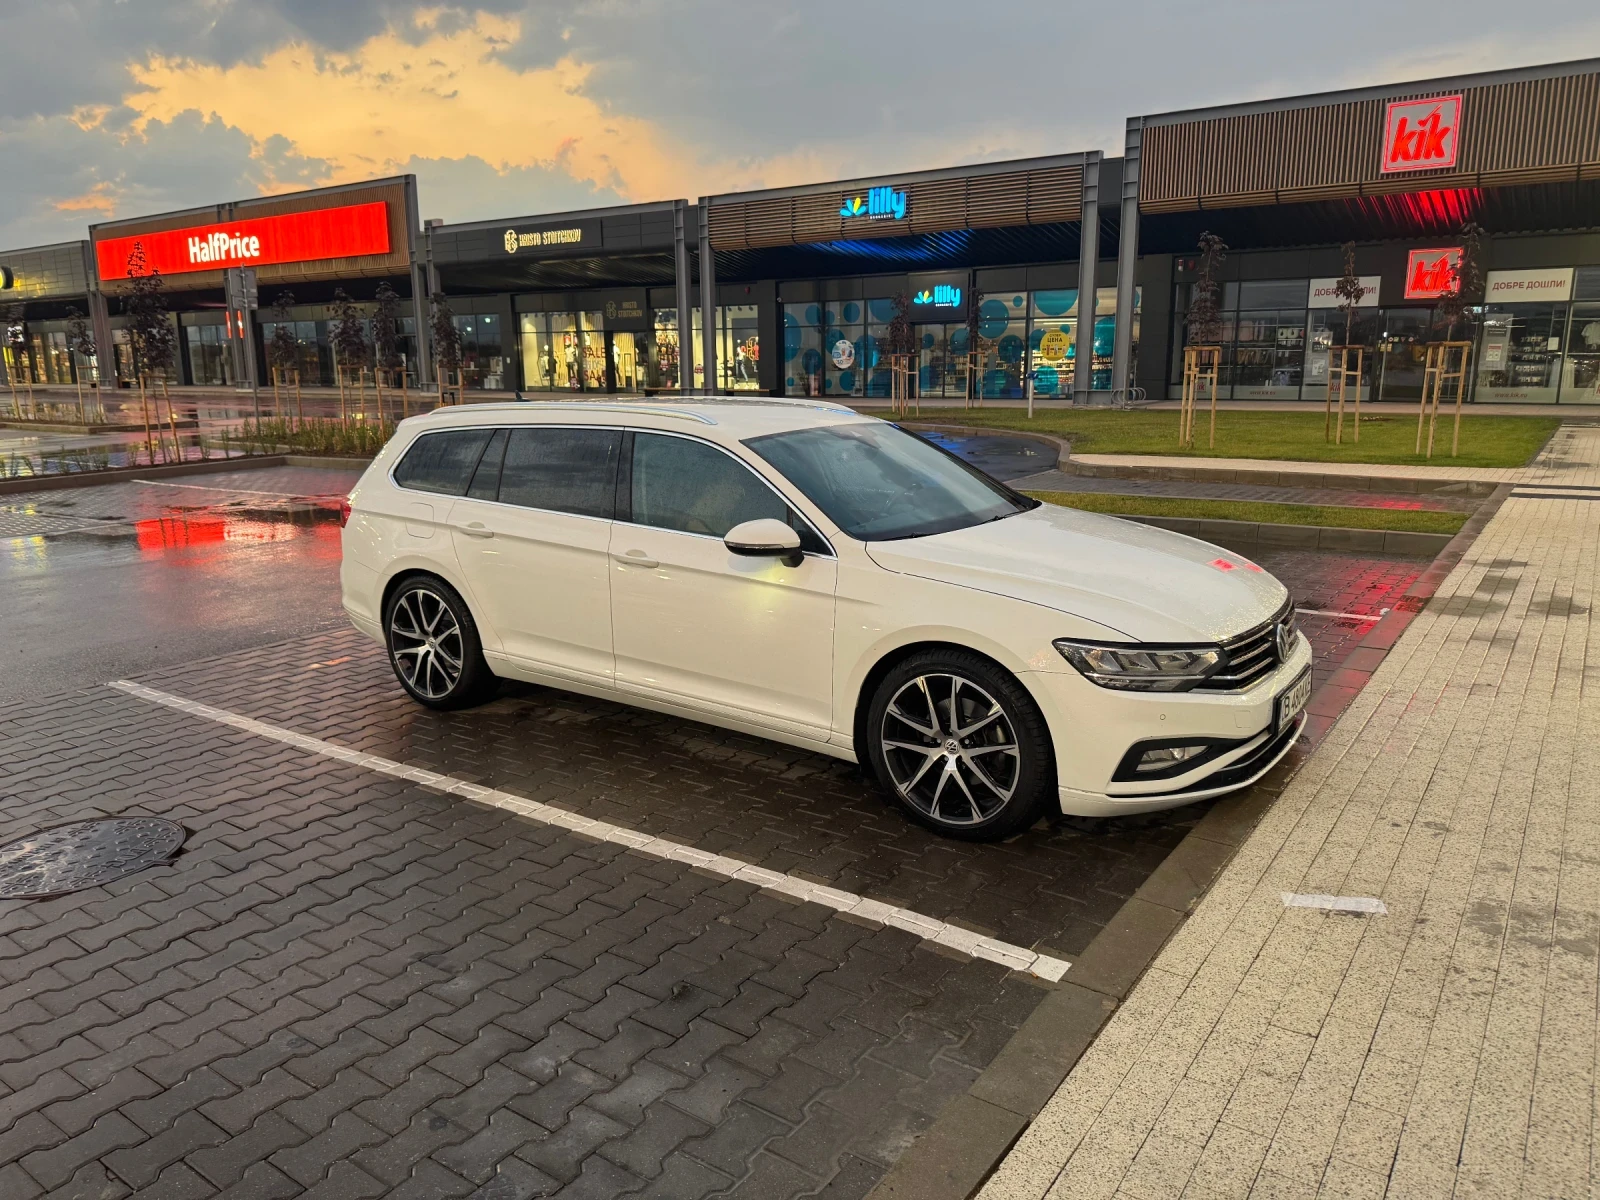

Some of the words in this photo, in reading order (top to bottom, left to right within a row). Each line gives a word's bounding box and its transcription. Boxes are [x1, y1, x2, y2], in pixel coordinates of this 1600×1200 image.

[869, 187, 906, 220] lilly
[188, 232, 260, 263] HalfPrice
[934, 284, 961, 307] lilly
[1492, 281, 1525, 291] ДОБРЕ
[1526, 280, 1566, 290] ДОШЛИ!
[583, 346, 606, 358] SALE
